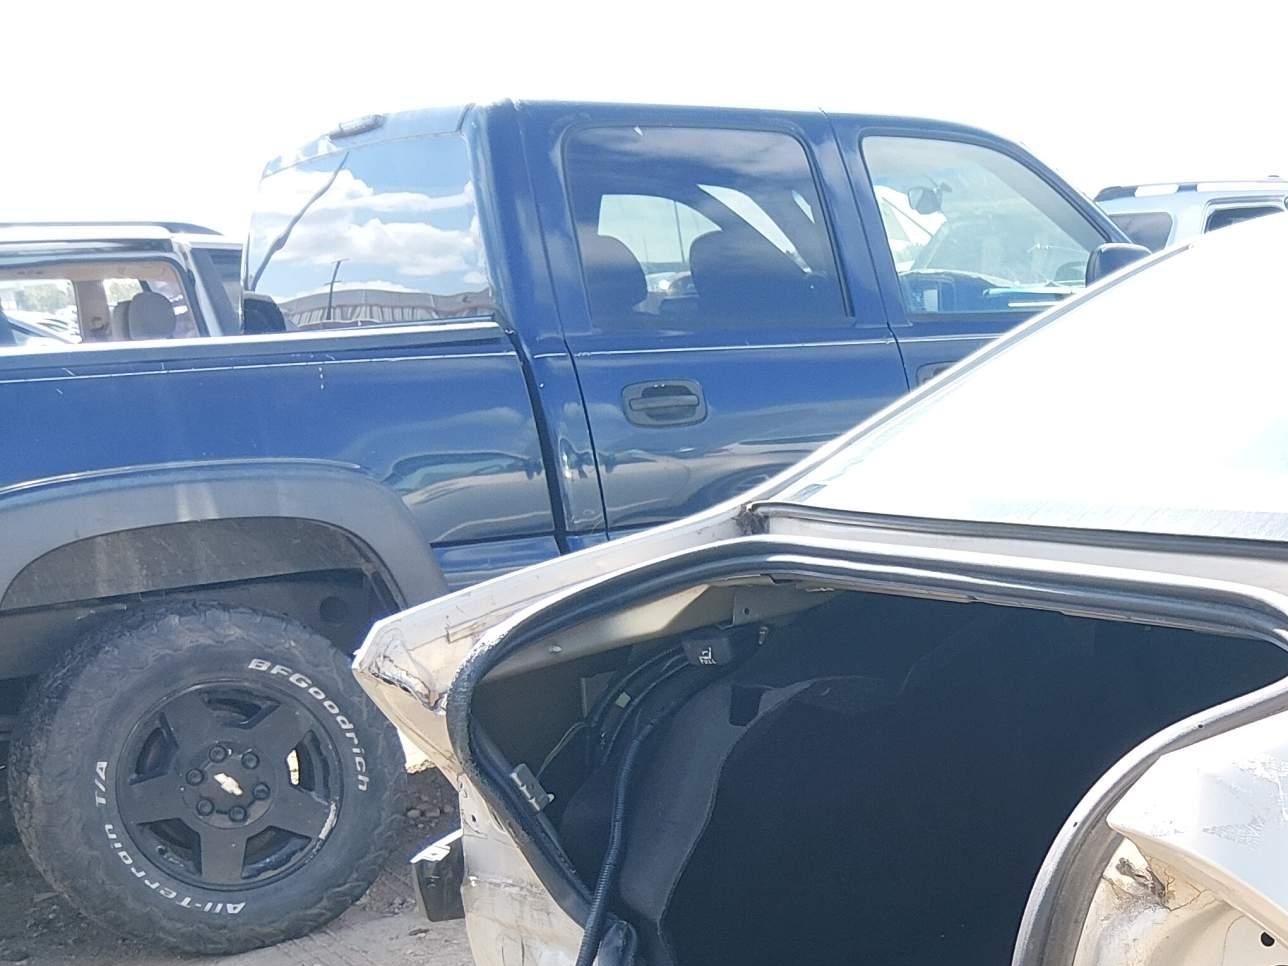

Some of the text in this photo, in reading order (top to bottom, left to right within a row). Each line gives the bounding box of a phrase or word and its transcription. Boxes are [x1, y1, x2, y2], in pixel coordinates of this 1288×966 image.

[247, 658, 370, 791] BFGoodrich
[95, 761, 246, 914] All-Terrain T/A
